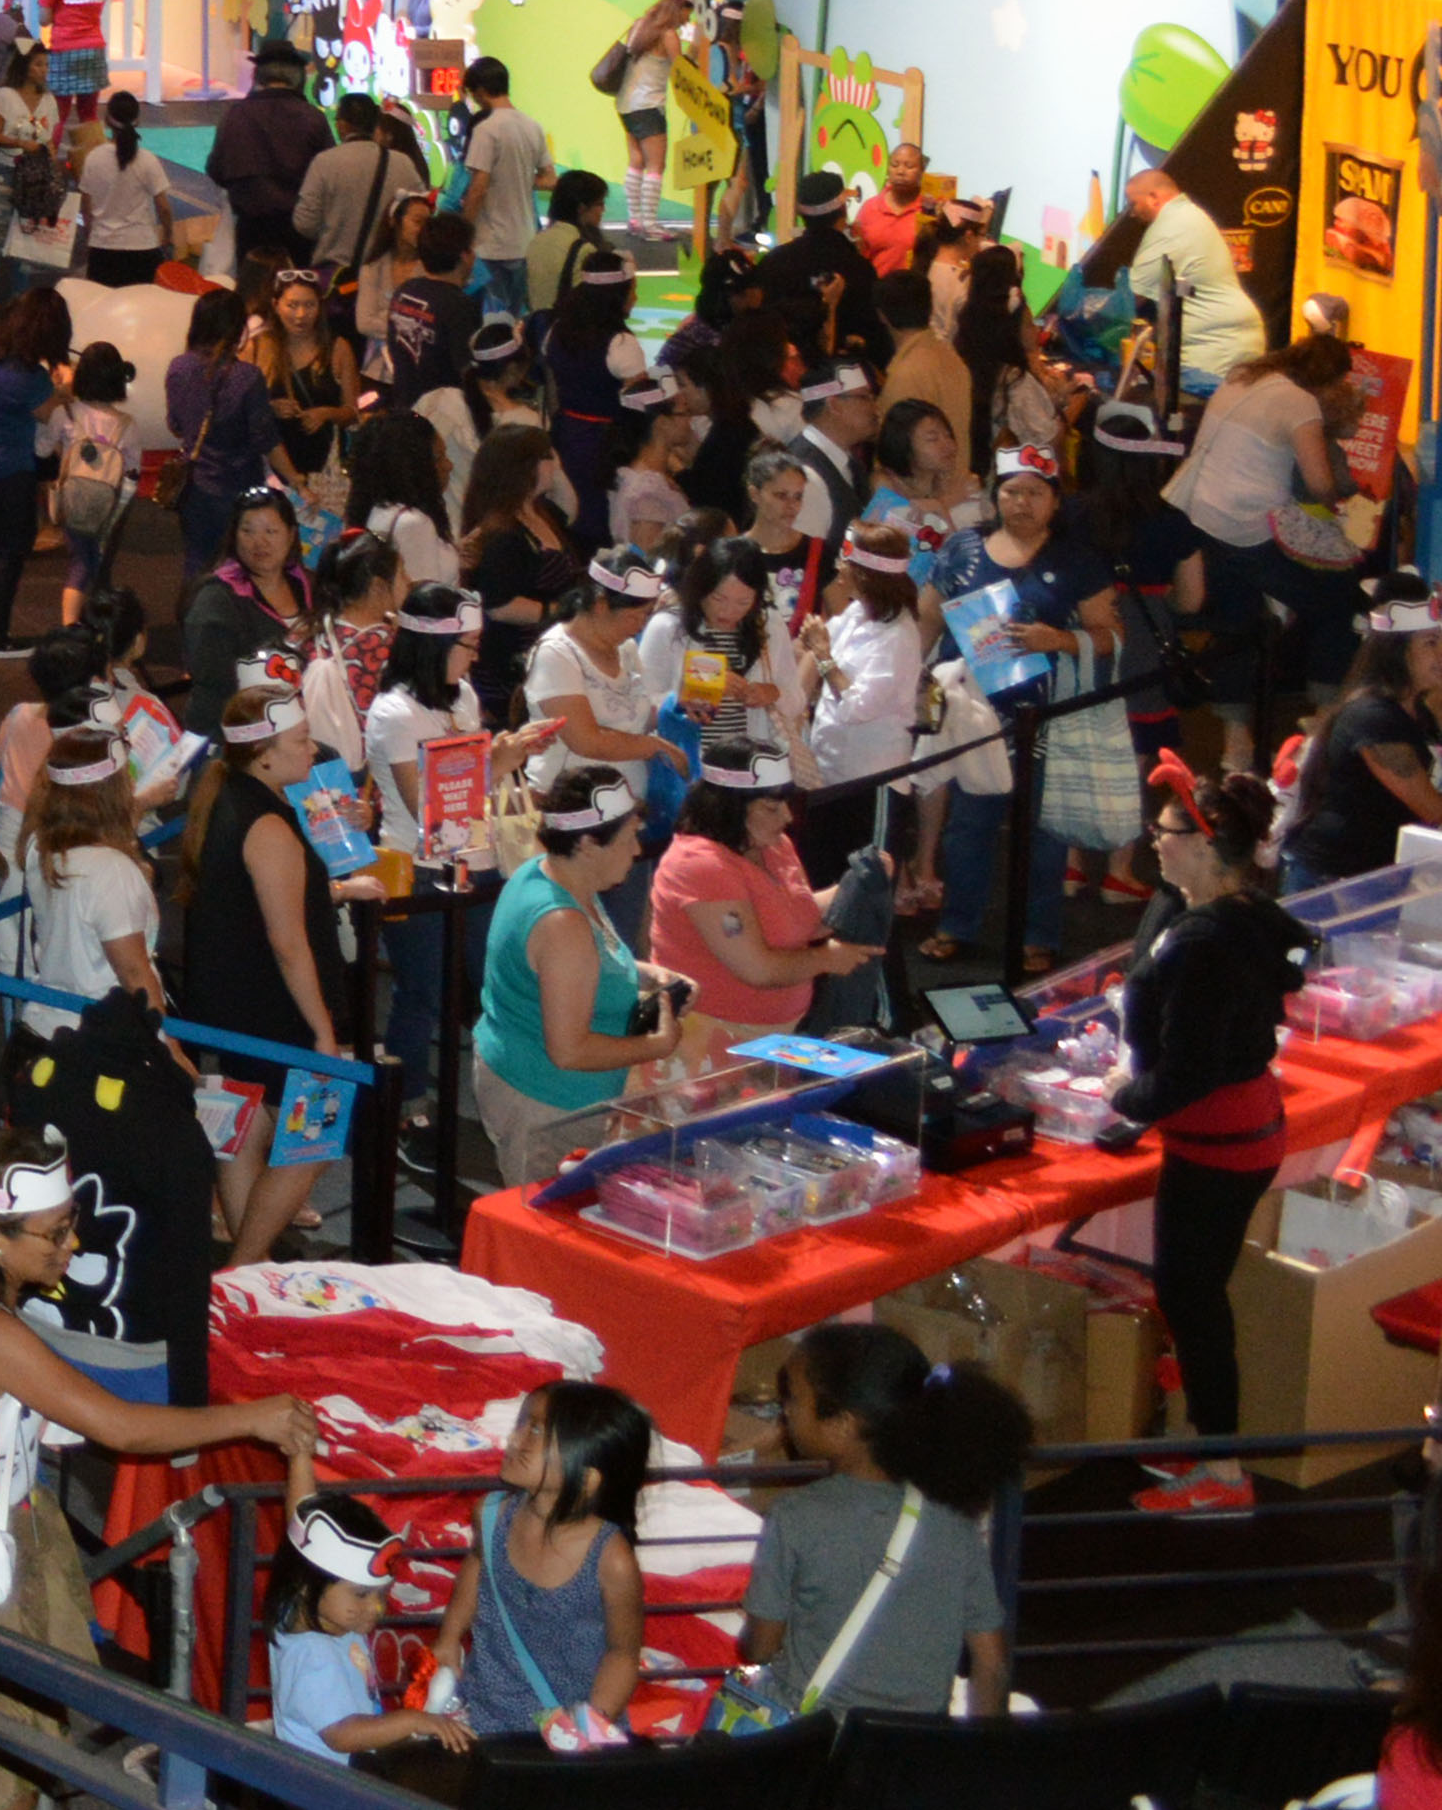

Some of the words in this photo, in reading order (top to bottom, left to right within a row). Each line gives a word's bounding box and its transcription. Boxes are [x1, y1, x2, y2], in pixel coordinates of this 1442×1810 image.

[1326, 43, 1405, 99] YOU
[682, 150, 714, 171] HOME
[437, 778, 474, 793] PLEASE
[443, 789, 469, 802] WAIT
[443, 801, 469, 814] HERE
